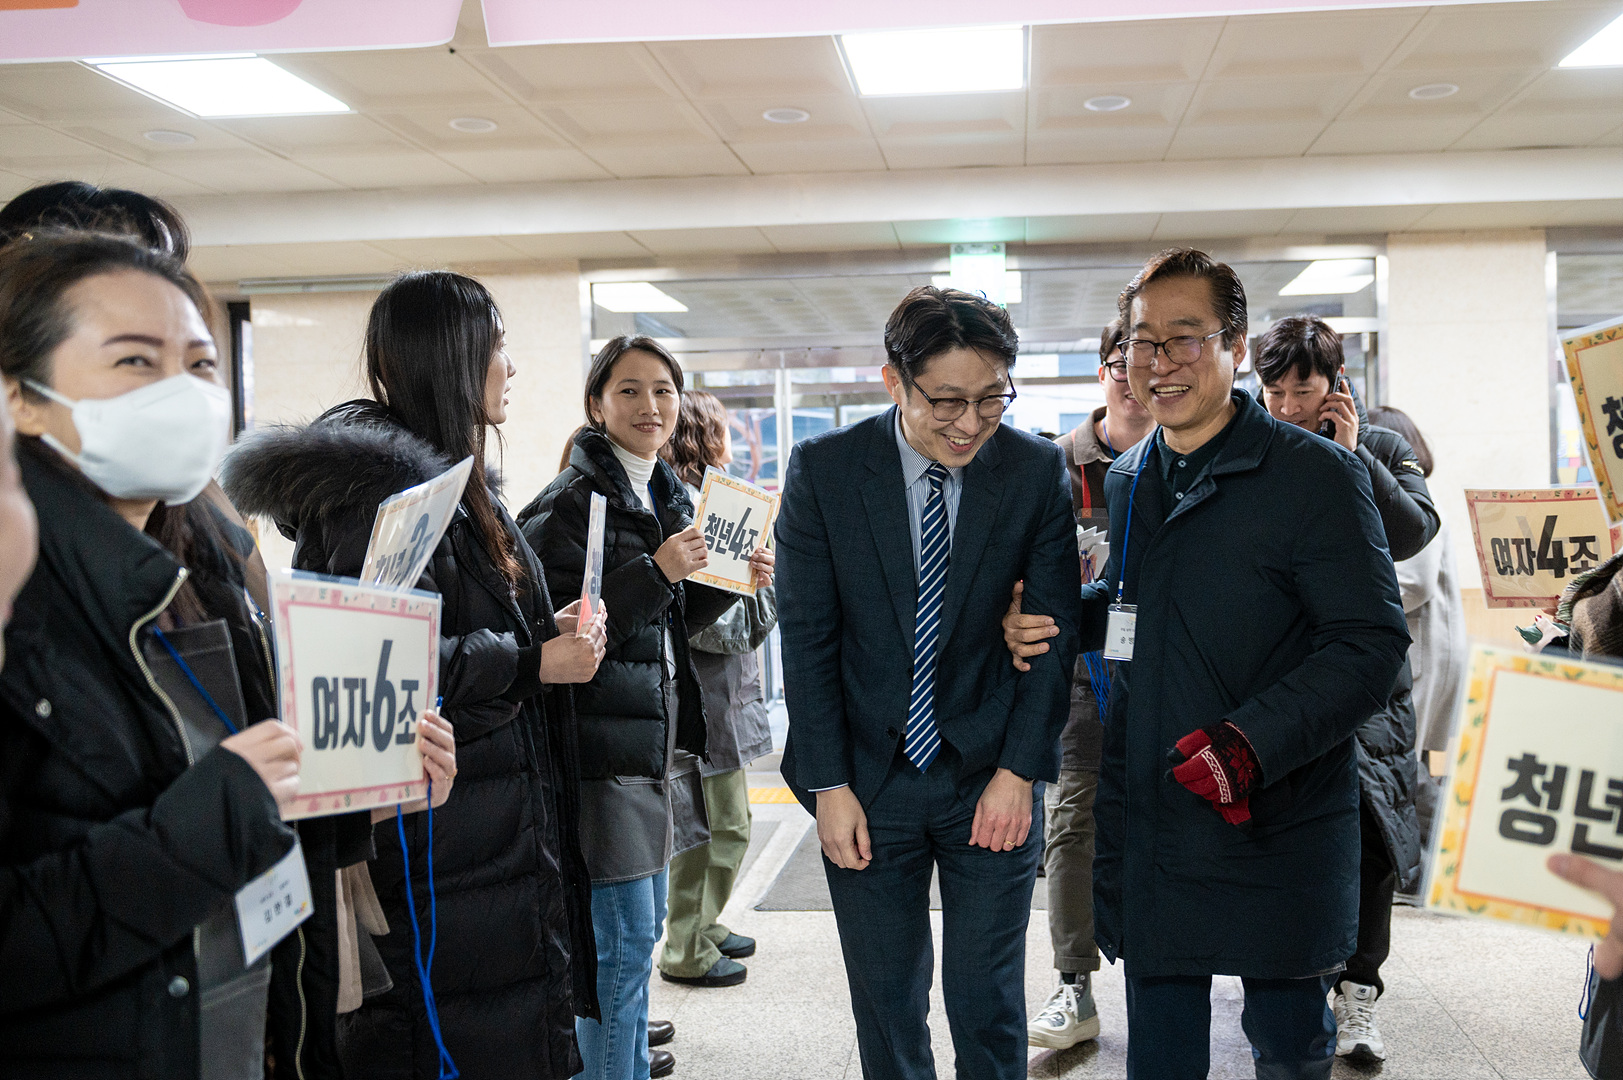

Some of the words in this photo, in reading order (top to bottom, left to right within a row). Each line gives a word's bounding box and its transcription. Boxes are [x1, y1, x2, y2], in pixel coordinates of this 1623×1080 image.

[704, 507, 759, 561] 청년4조
[1491, 515, 1599, 578] 여자4조
[312, 639, 419, 752] 여자6조
